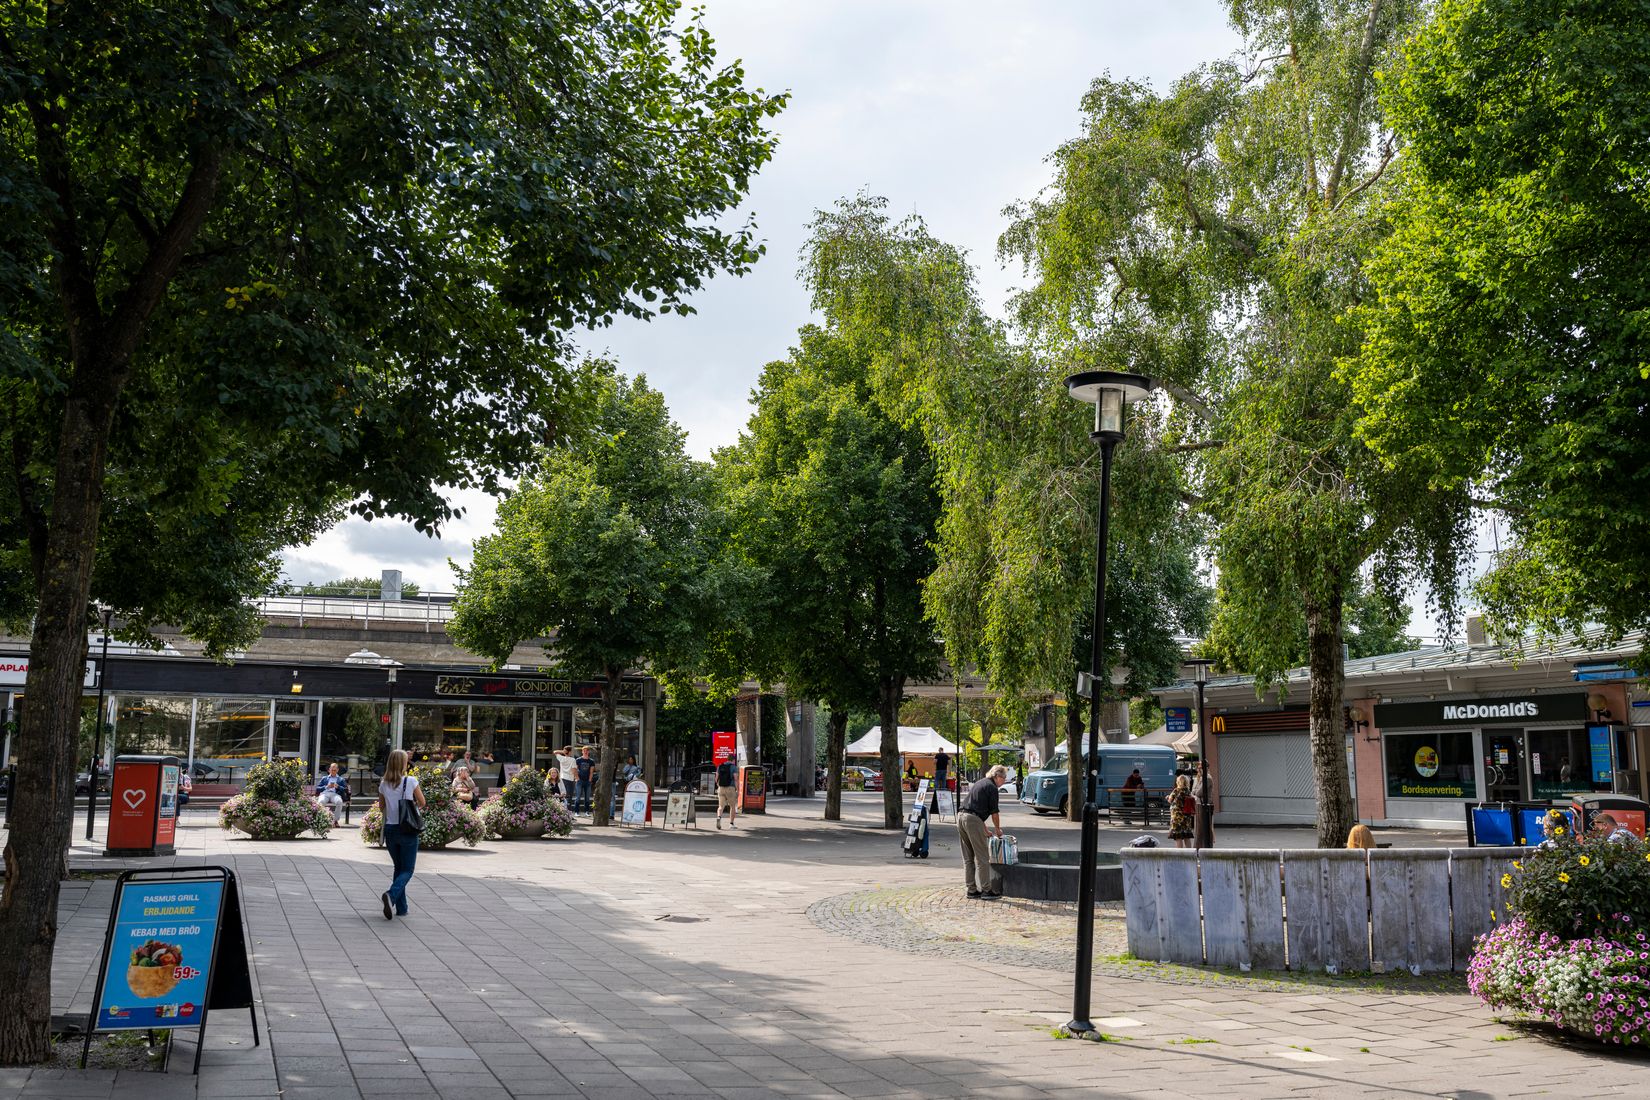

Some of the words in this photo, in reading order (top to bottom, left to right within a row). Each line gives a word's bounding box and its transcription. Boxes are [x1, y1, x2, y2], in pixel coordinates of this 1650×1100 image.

[515, 681, 572, 692] KONDITORI
[1443, 702, 1539, 719] McDonald's
[1402, 785, 1464, 796] Bordsservering.
[143, 895, 176, 903] RASMUS
[177, 894, 200, 902] GRILL
[143, 906, 196, 916] ERBJUDANDE
[130, 928, 158, 937] KEBAB
[159, 927, 177, 936] MED
[178, 926, 201, 936] BRÖD
[173, 966, 201, 980] 59:-
